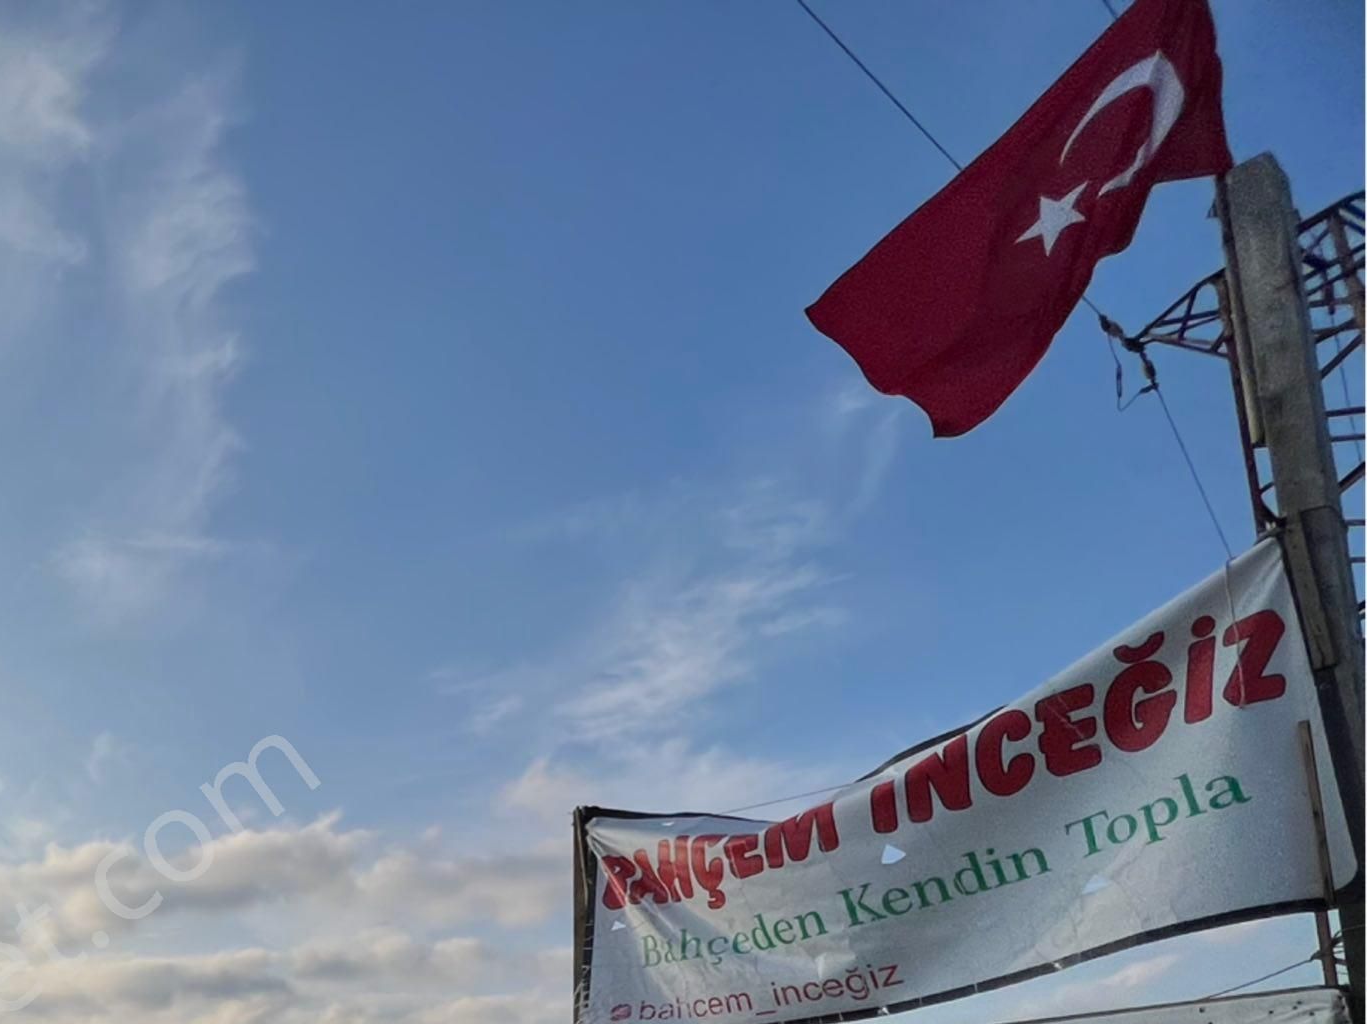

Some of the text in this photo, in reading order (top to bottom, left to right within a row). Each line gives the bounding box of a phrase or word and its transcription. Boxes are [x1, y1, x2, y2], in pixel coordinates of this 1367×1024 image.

[641, 771, 1252, 969] Bahçeden Kendin Topla
